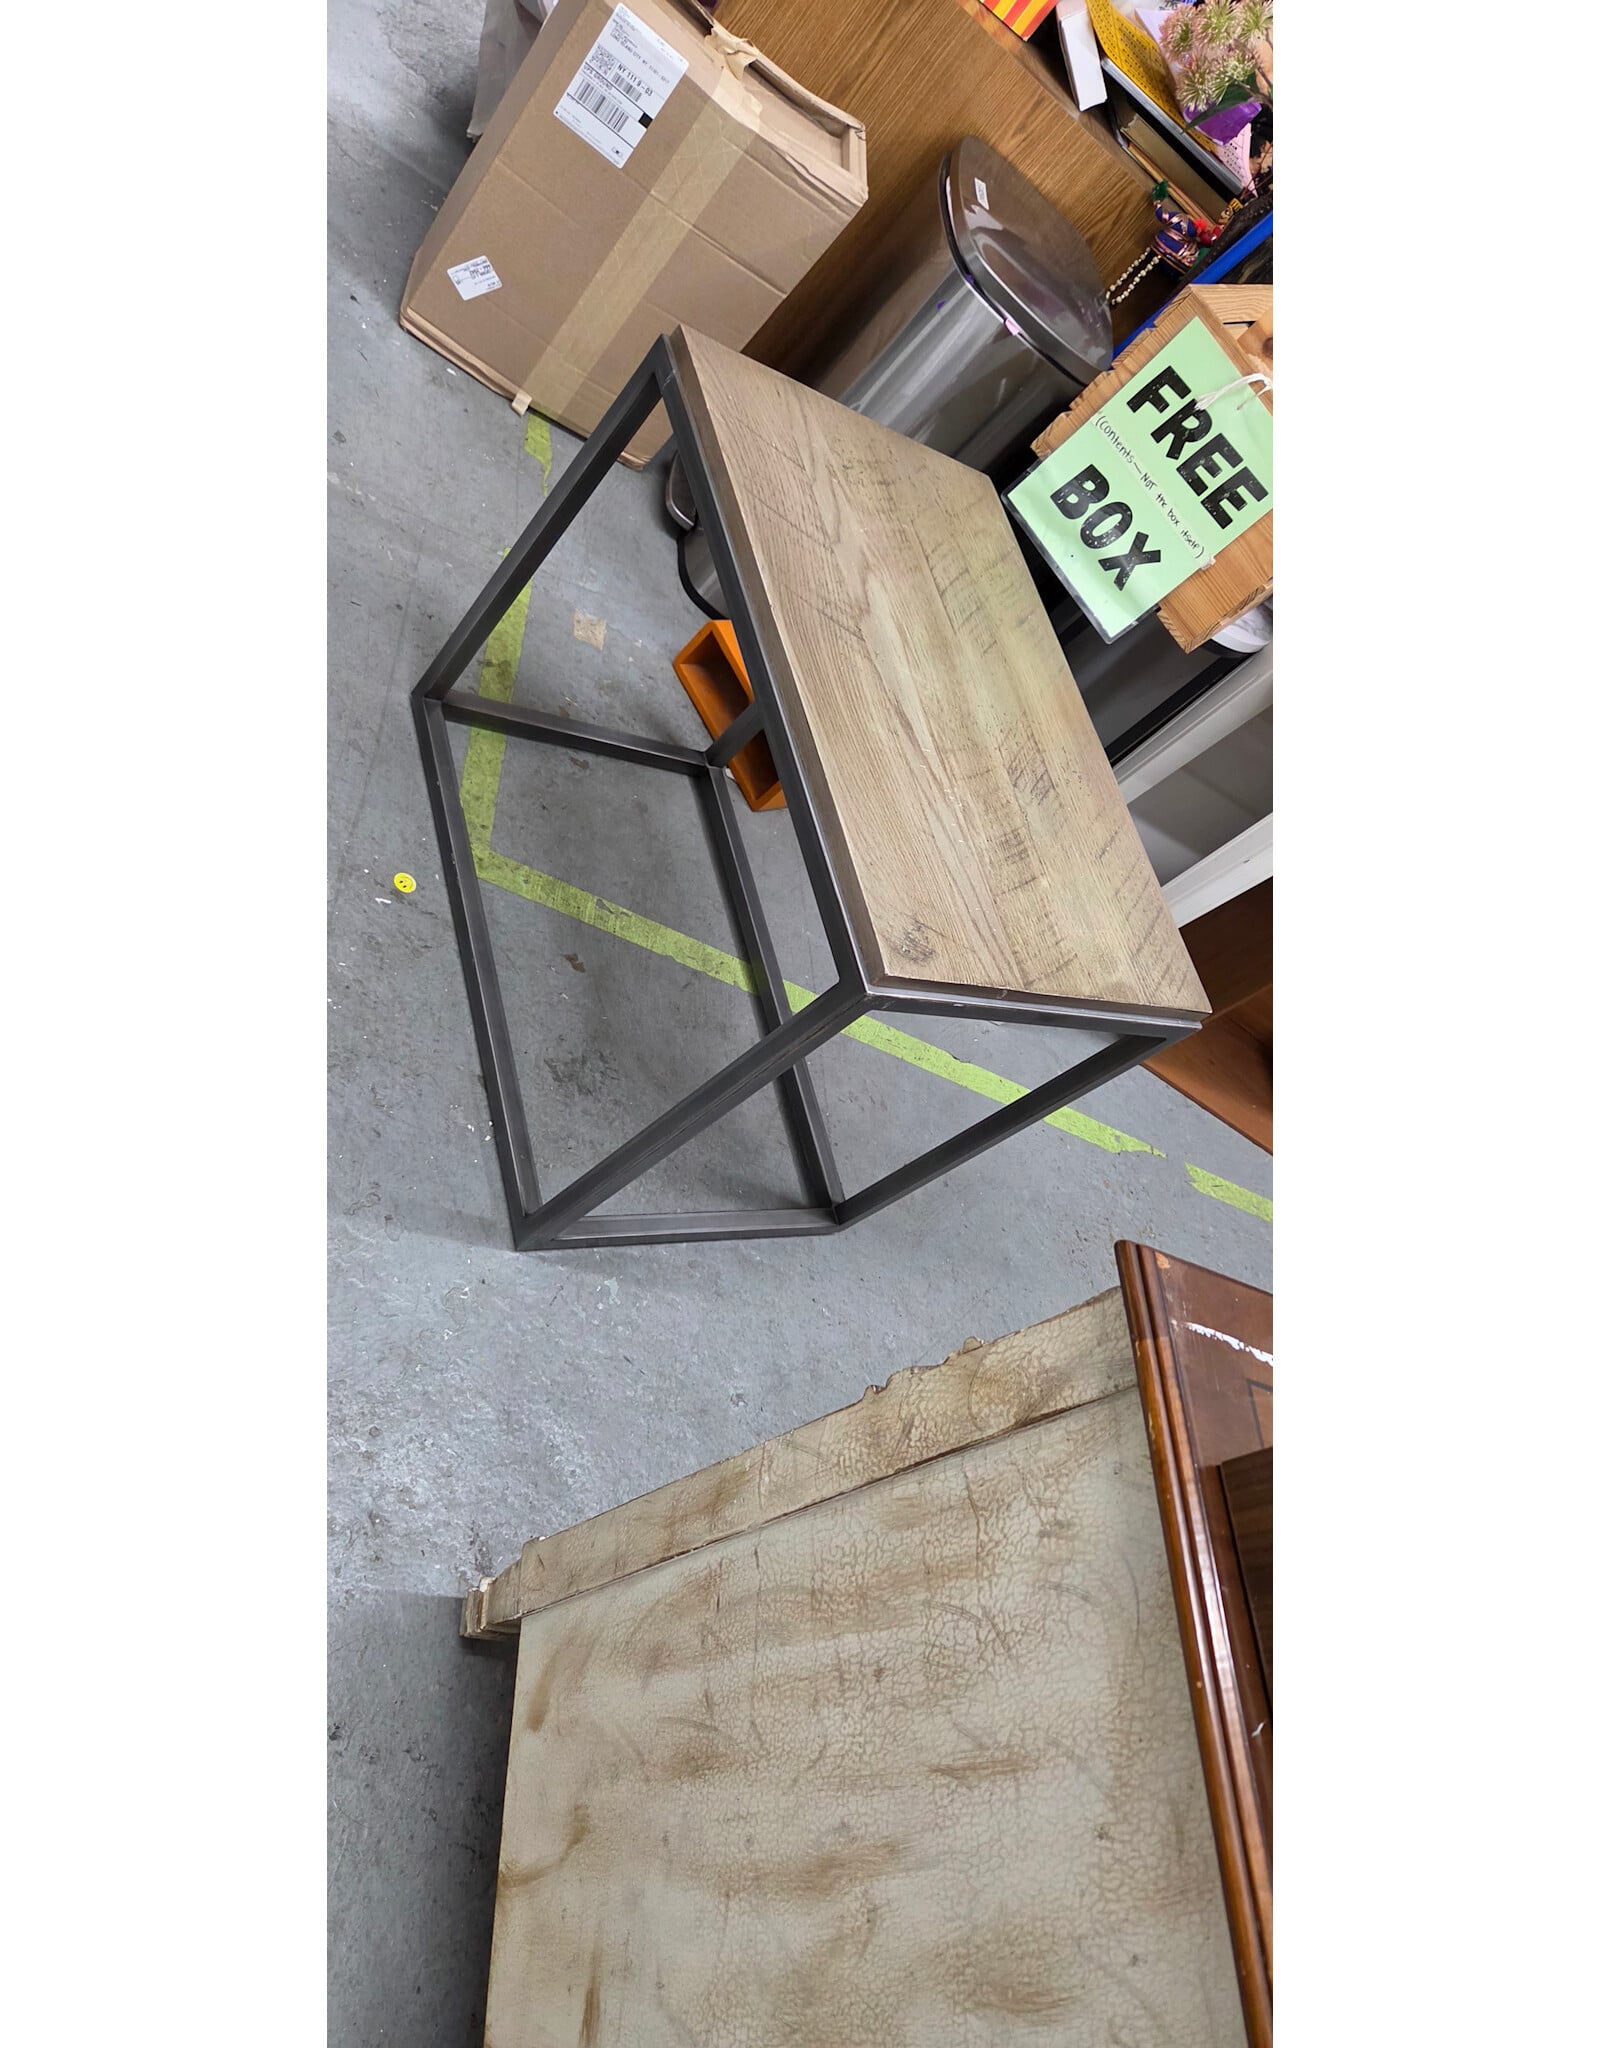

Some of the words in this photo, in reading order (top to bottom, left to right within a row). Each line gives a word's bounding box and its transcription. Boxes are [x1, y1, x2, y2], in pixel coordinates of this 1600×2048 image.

[617, 63, 627, 75] NY
[1127, 365, 1269, 530] FREE
[1050, 464, 1161, 591] BOX
[1156, 493, 1168, 508] the
[1167, 508, 1180, 527] box
